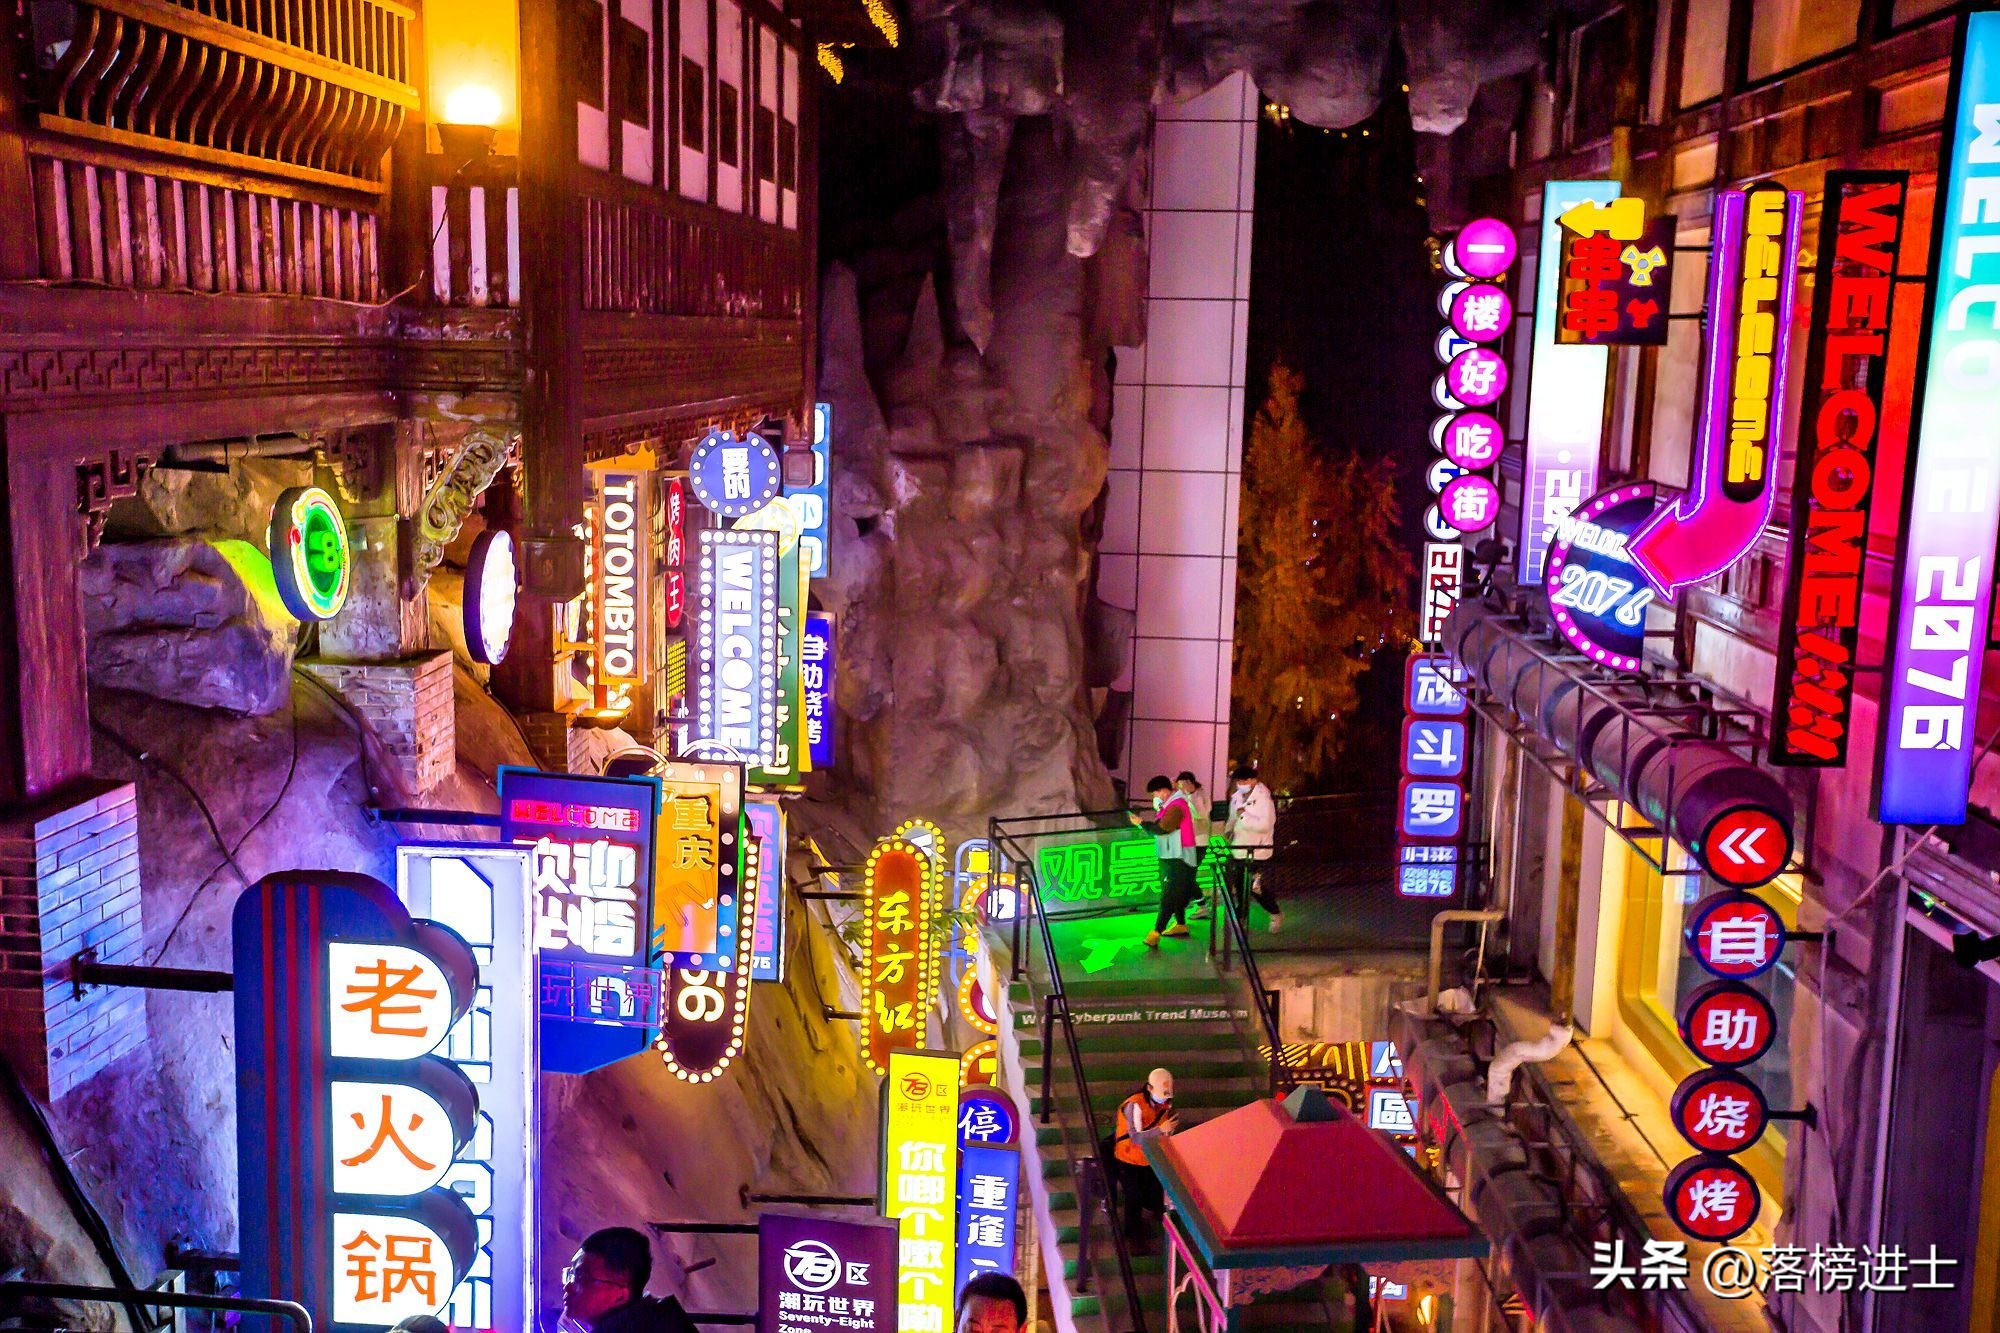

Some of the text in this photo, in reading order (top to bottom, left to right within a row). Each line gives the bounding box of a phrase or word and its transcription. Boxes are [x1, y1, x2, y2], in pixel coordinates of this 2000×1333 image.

[1566, 233, 1622, 338] 串串
[1728, 191, 1785, 483] WELCOME
[1451, 243, 1506, 522] 一楼好吃街
[603, 480, 635, 676] TOTOMBTO
[1550, 563, 1656, 627] 2076
[721, 550, 752, 748] WELCOME
[1900, 555, 1981, 750] 2076
[1410, 666, 1462, 826] 魂斗罗
[510, 800, 640, 832] WELCOME
[672, 797, 712, 871] 重庆
[1146, 1009, 1187, 1021] Trend
[1688, 916, 1767, 1222] 自助烧烤
[340, 957, 438, 1307] 老火锅
[967, 1174, 1010, 1281] 重逢
[778, 1291, 875, 1317] 潮玩世界
[778, 1310, 875, 1330] Seventy-Eight
